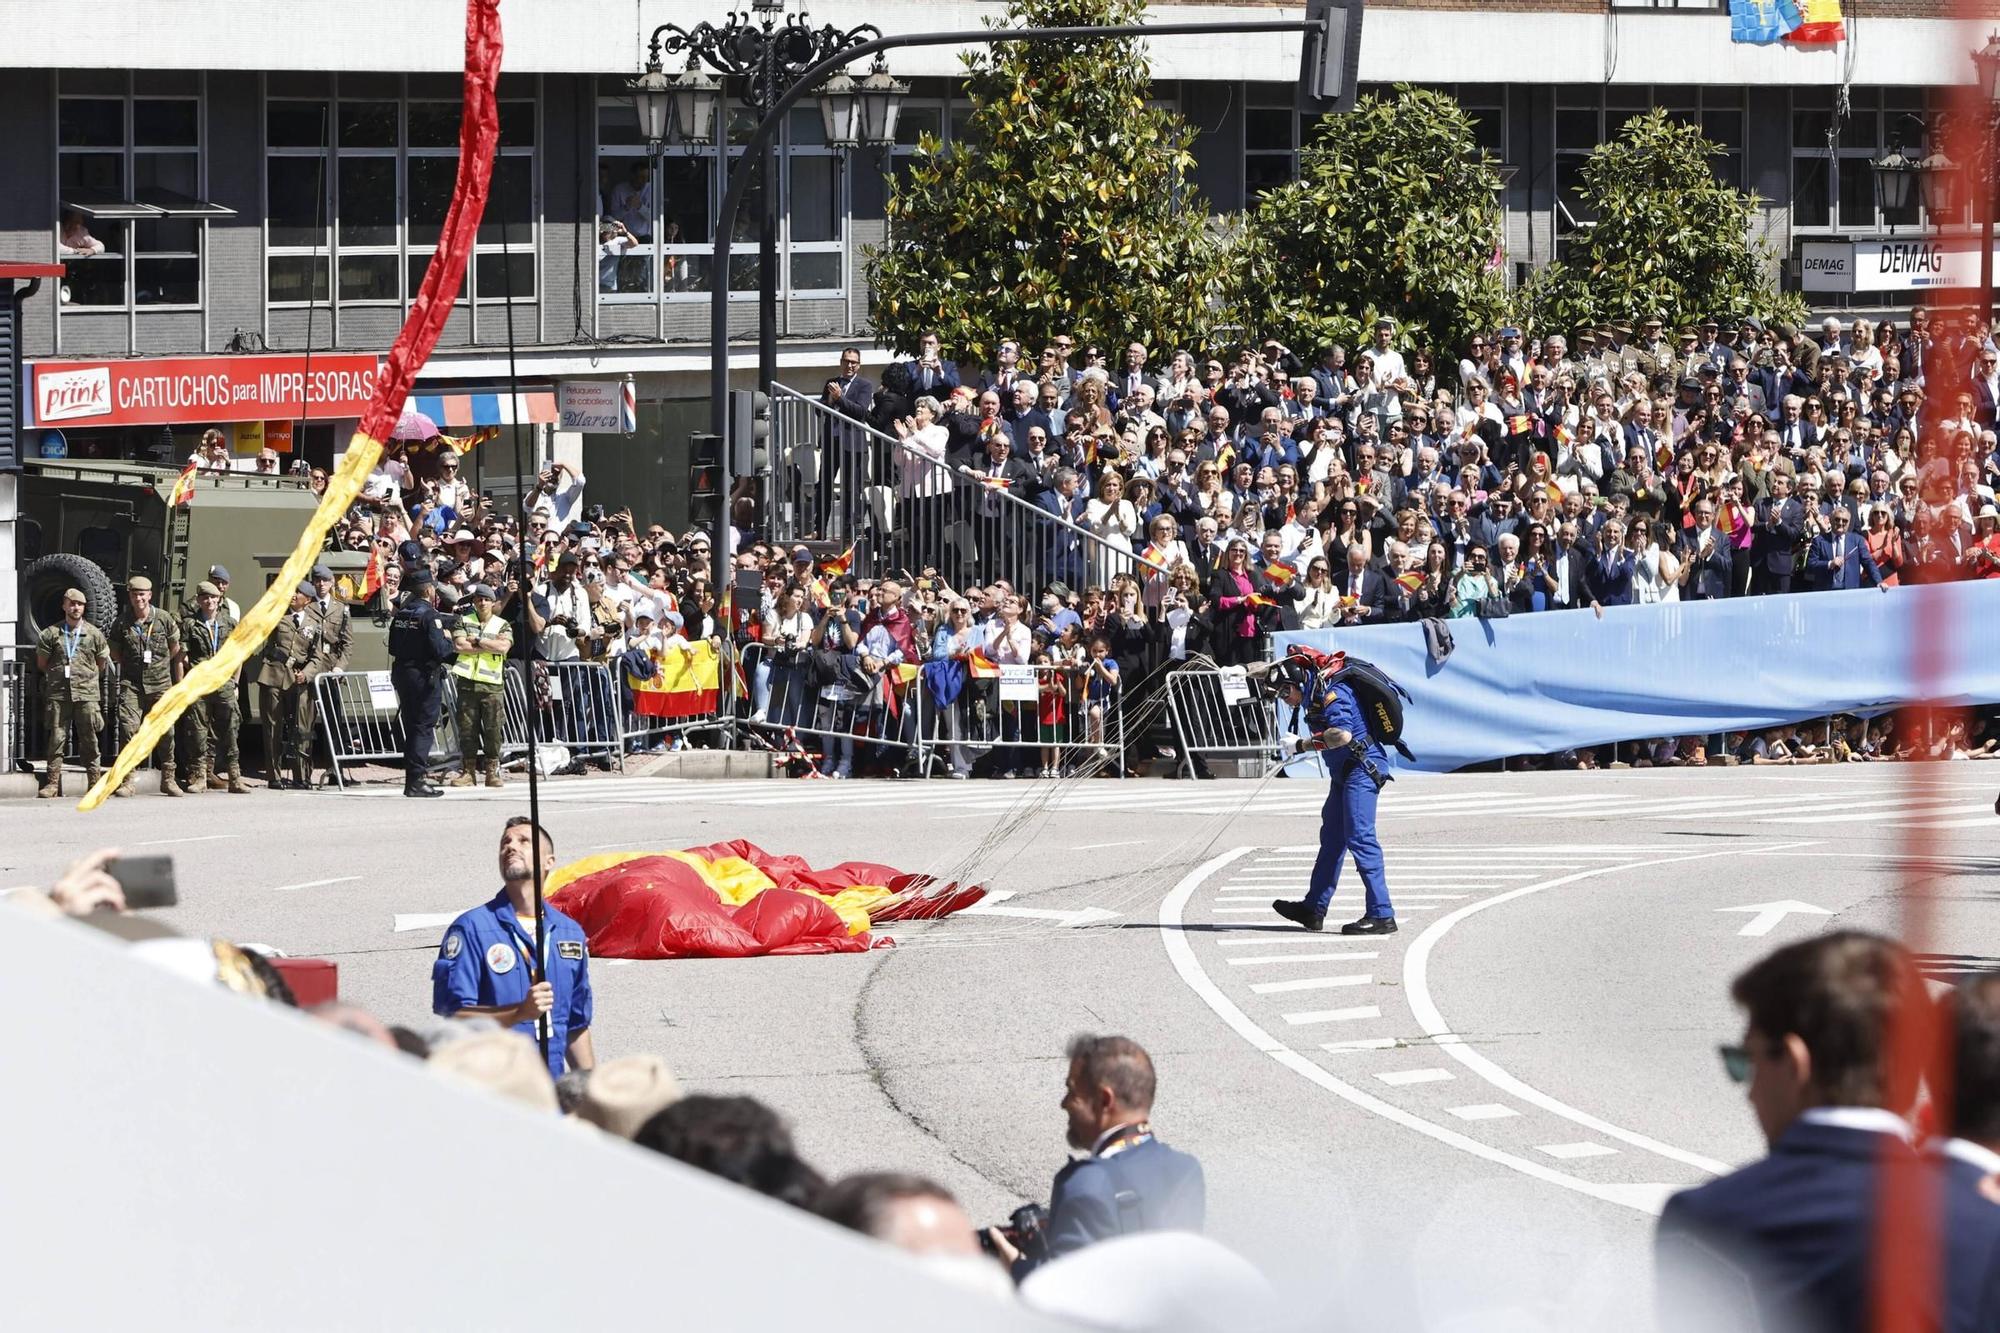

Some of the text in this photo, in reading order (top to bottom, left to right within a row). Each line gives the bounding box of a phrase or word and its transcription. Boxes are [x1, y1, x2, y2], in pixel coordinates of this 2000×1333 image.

[1804, 258, 1845, 270] DEMAG
[1879, 243, 1943, 274] DEMAG
[45, 377, 106, 416] prink
[118, 370, 374, 409] CARTUCHOS para IMPRESORAS
[564, 410, 618, 427] Marco
[41, 446, 65, 455] DIGI
